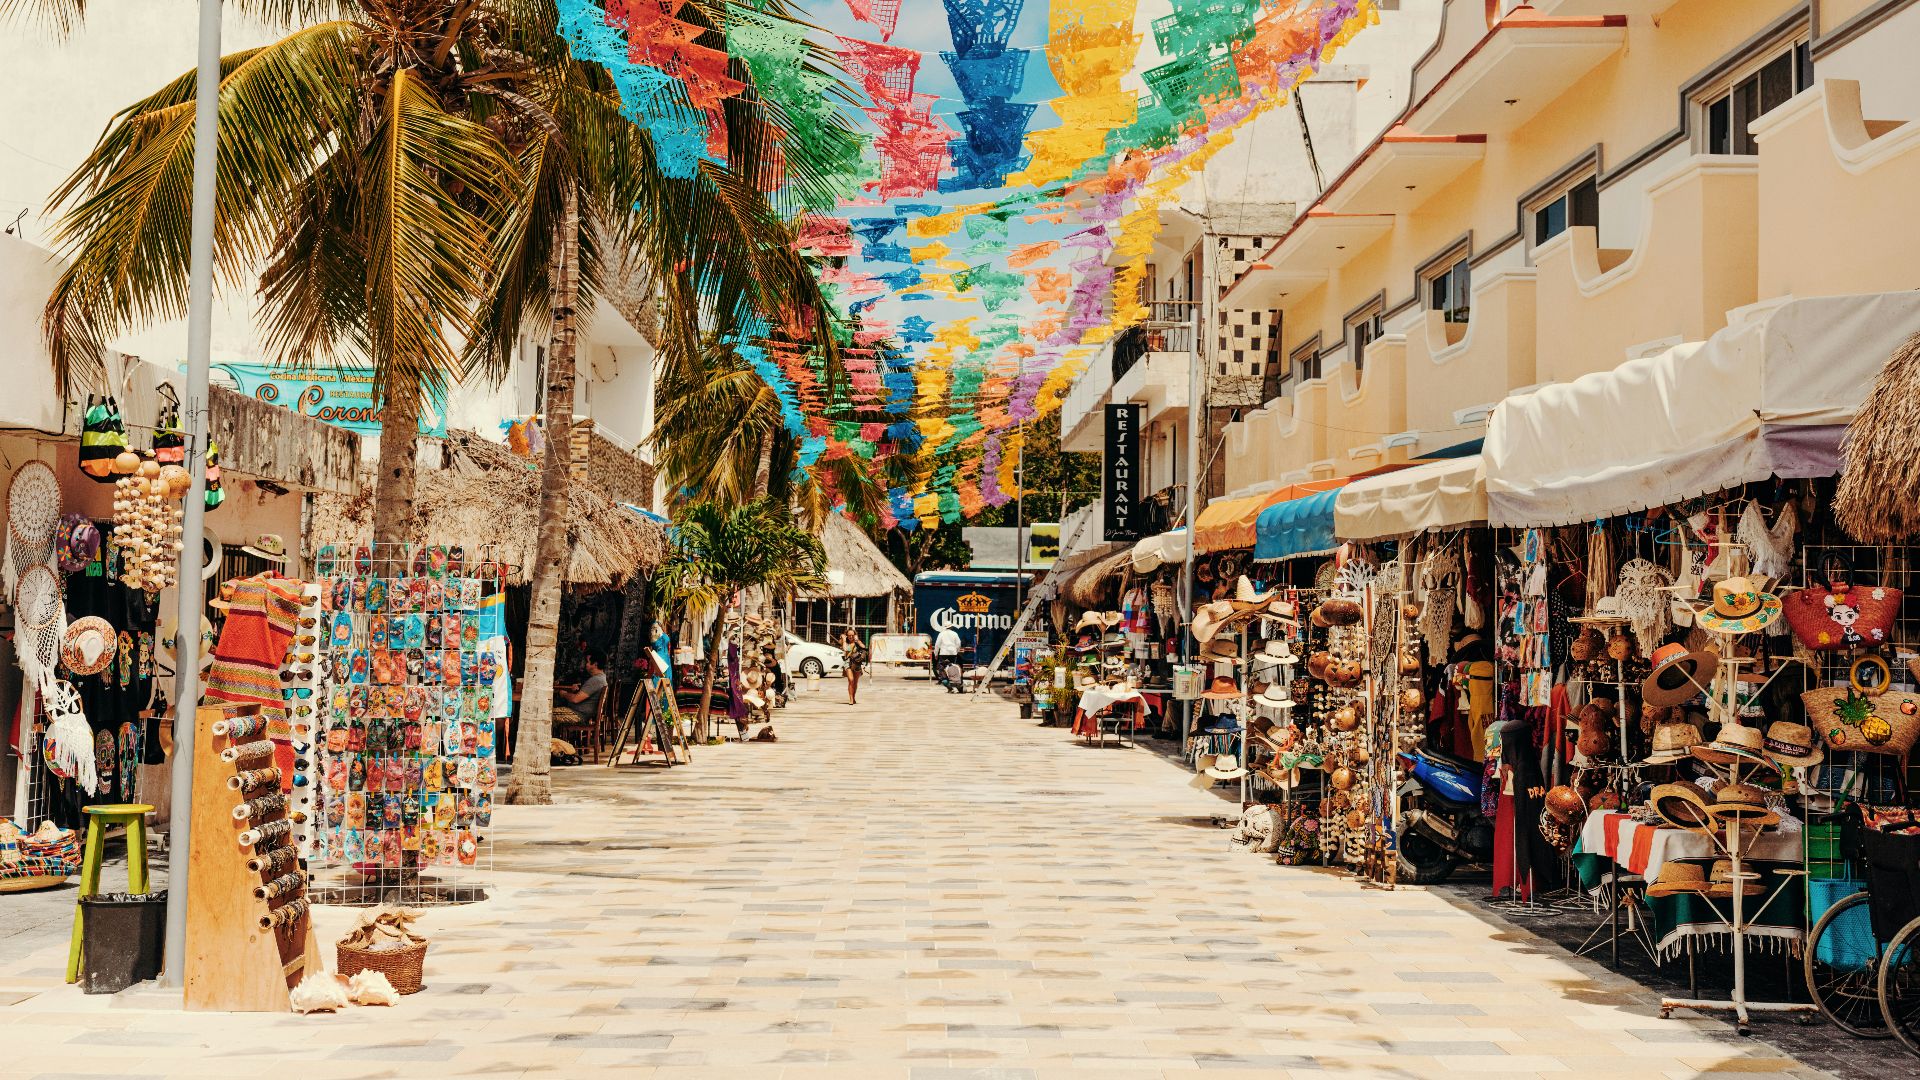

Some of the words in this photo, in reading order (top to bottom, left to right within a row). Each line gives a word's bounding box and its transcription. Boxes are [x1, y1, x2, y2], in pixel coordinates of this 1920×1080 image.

[270, 371, 297, 380] Cocina
[298, 372, 336, 382] Mexicana
[1115, 408, 1129, 527] RESTAURANT
[930, 607, 1011, 632] Corona
